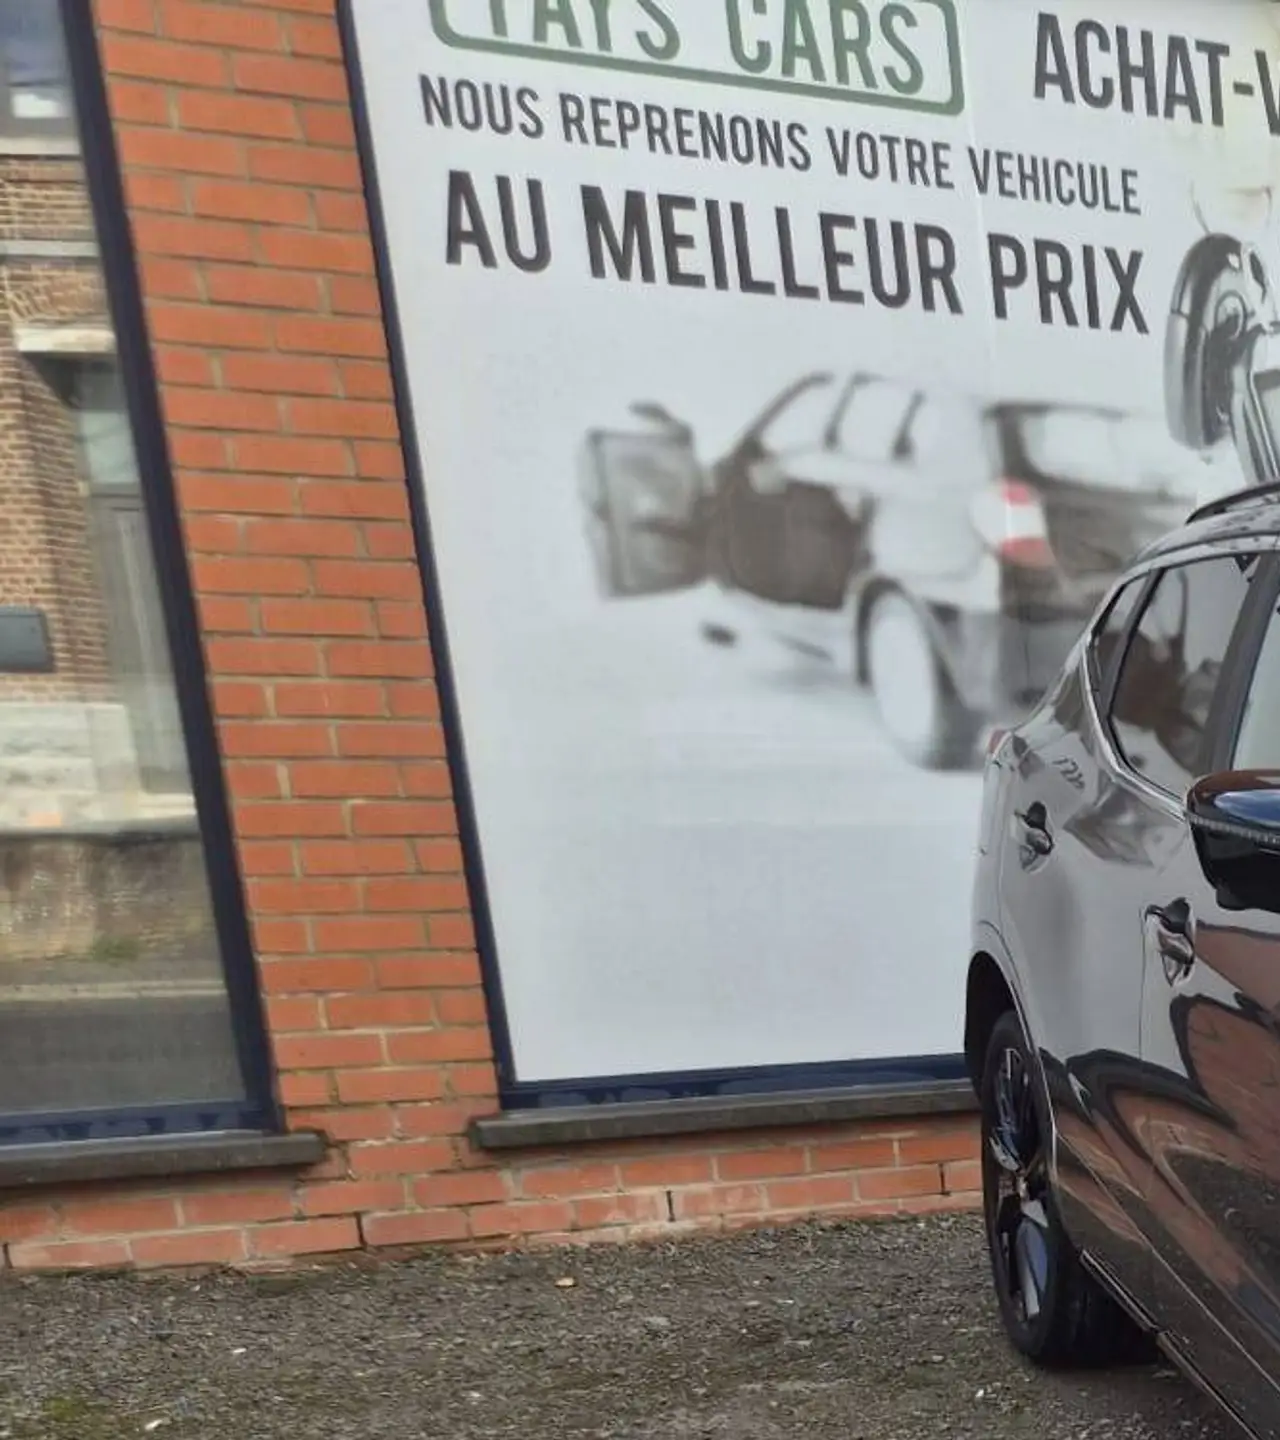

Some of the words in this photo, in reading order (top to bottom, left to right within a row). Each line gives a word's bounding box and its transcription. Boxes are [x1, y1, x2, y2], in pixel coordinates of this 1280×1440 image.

[727, 0, 924, 95] CARS
[419, 74, 545, 139] NOUS
[559, 92, 811, 171] REPRENONS
[826, 127, 954, 190] VOTRE
[967, 145, 1141, 214] VEHICULE
[445, 169, 552, 273] AU
[580, 184, 963, 315] MEILLEUR
[988, 232, 1150, 335] PRIX
